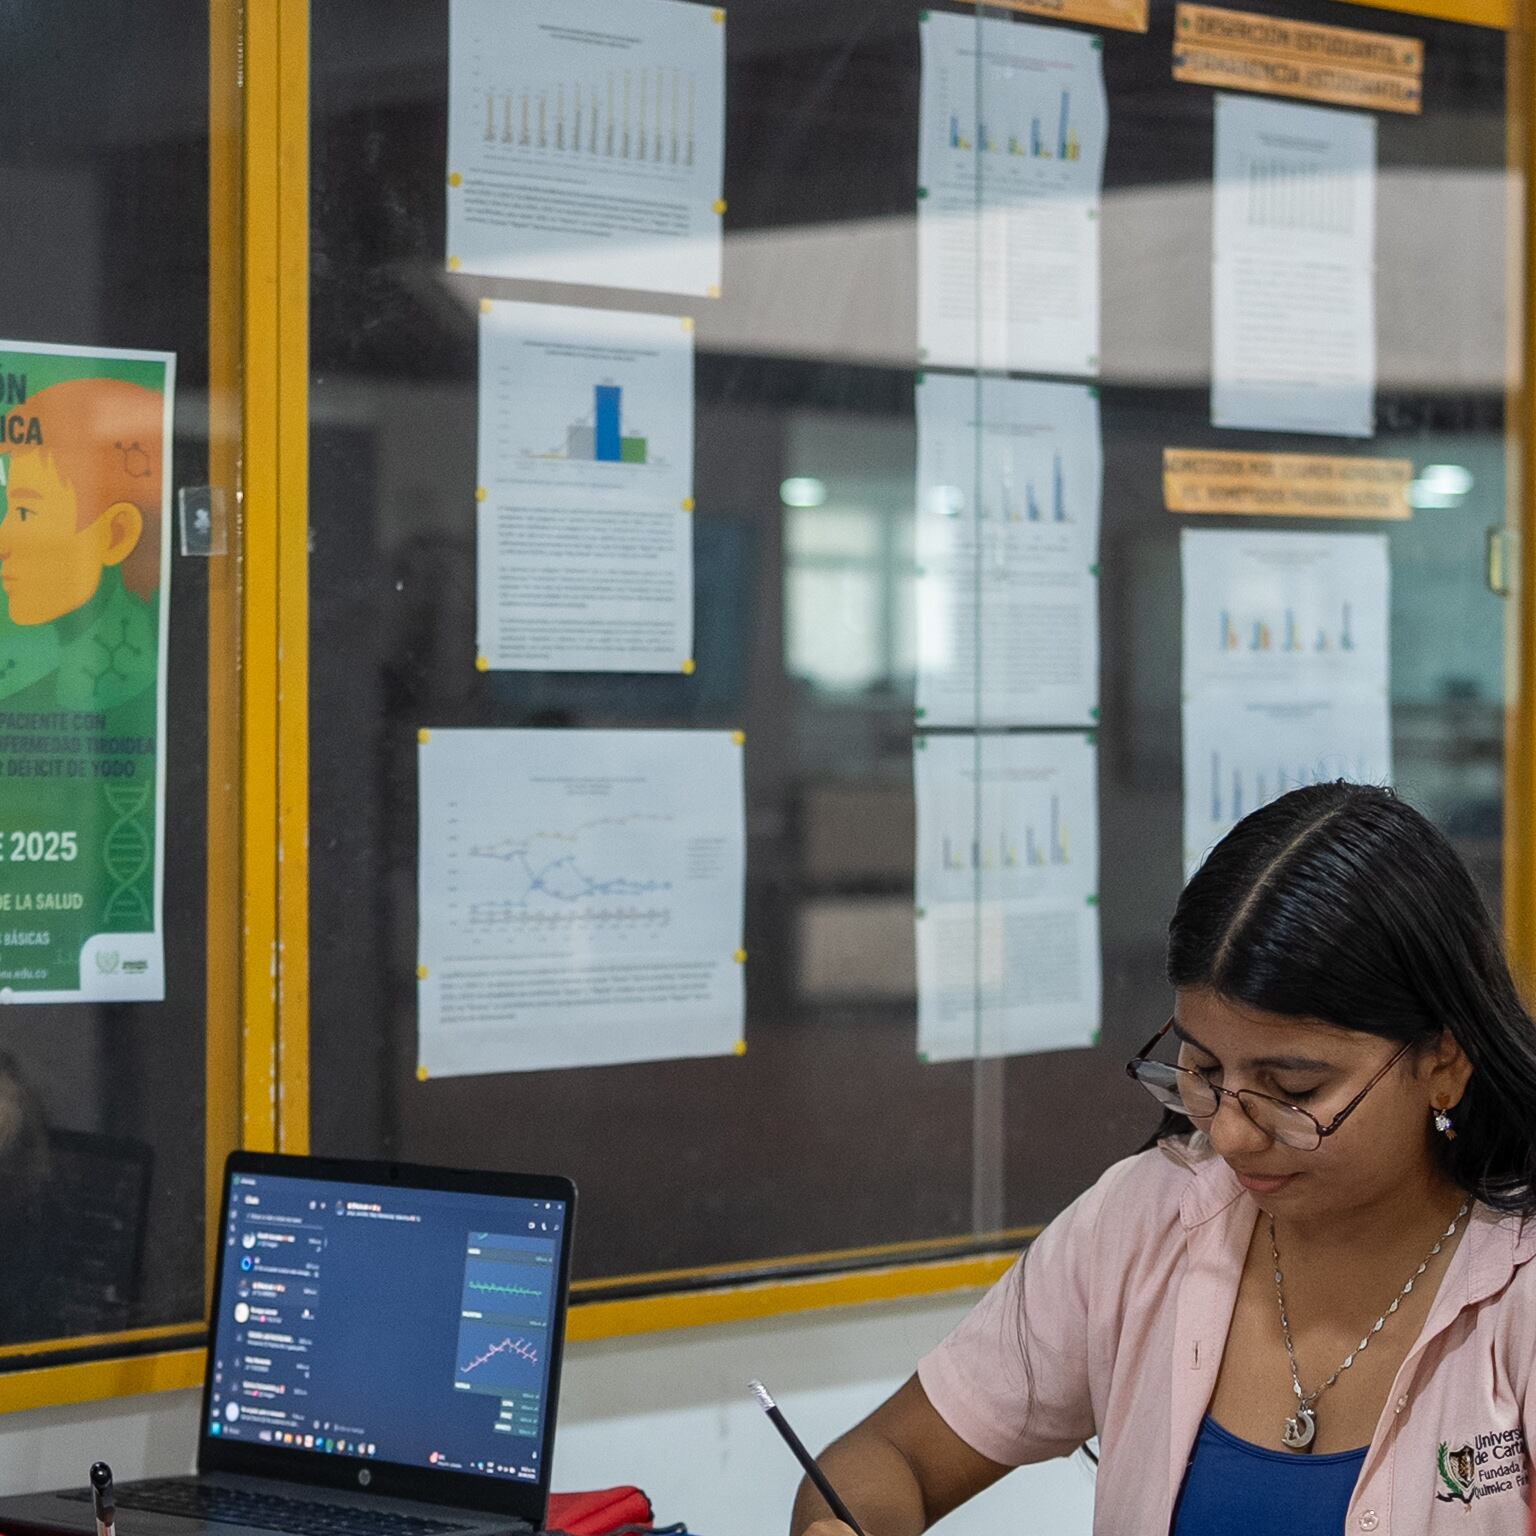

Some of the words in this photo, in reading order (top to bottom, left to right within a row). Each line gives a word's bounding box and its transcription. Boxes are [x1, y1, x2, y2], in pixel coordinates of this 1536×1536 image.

[10, 831, 78, 862] 2025
[15, 894, 33, 910] LA
[36, 893, 83, 910] SALUD
[4, 930, 50, 945] BÁSICAS
[1474, 1451, 1488, 1465] de
[1479, 1461, 1520, 1482] Fundada
